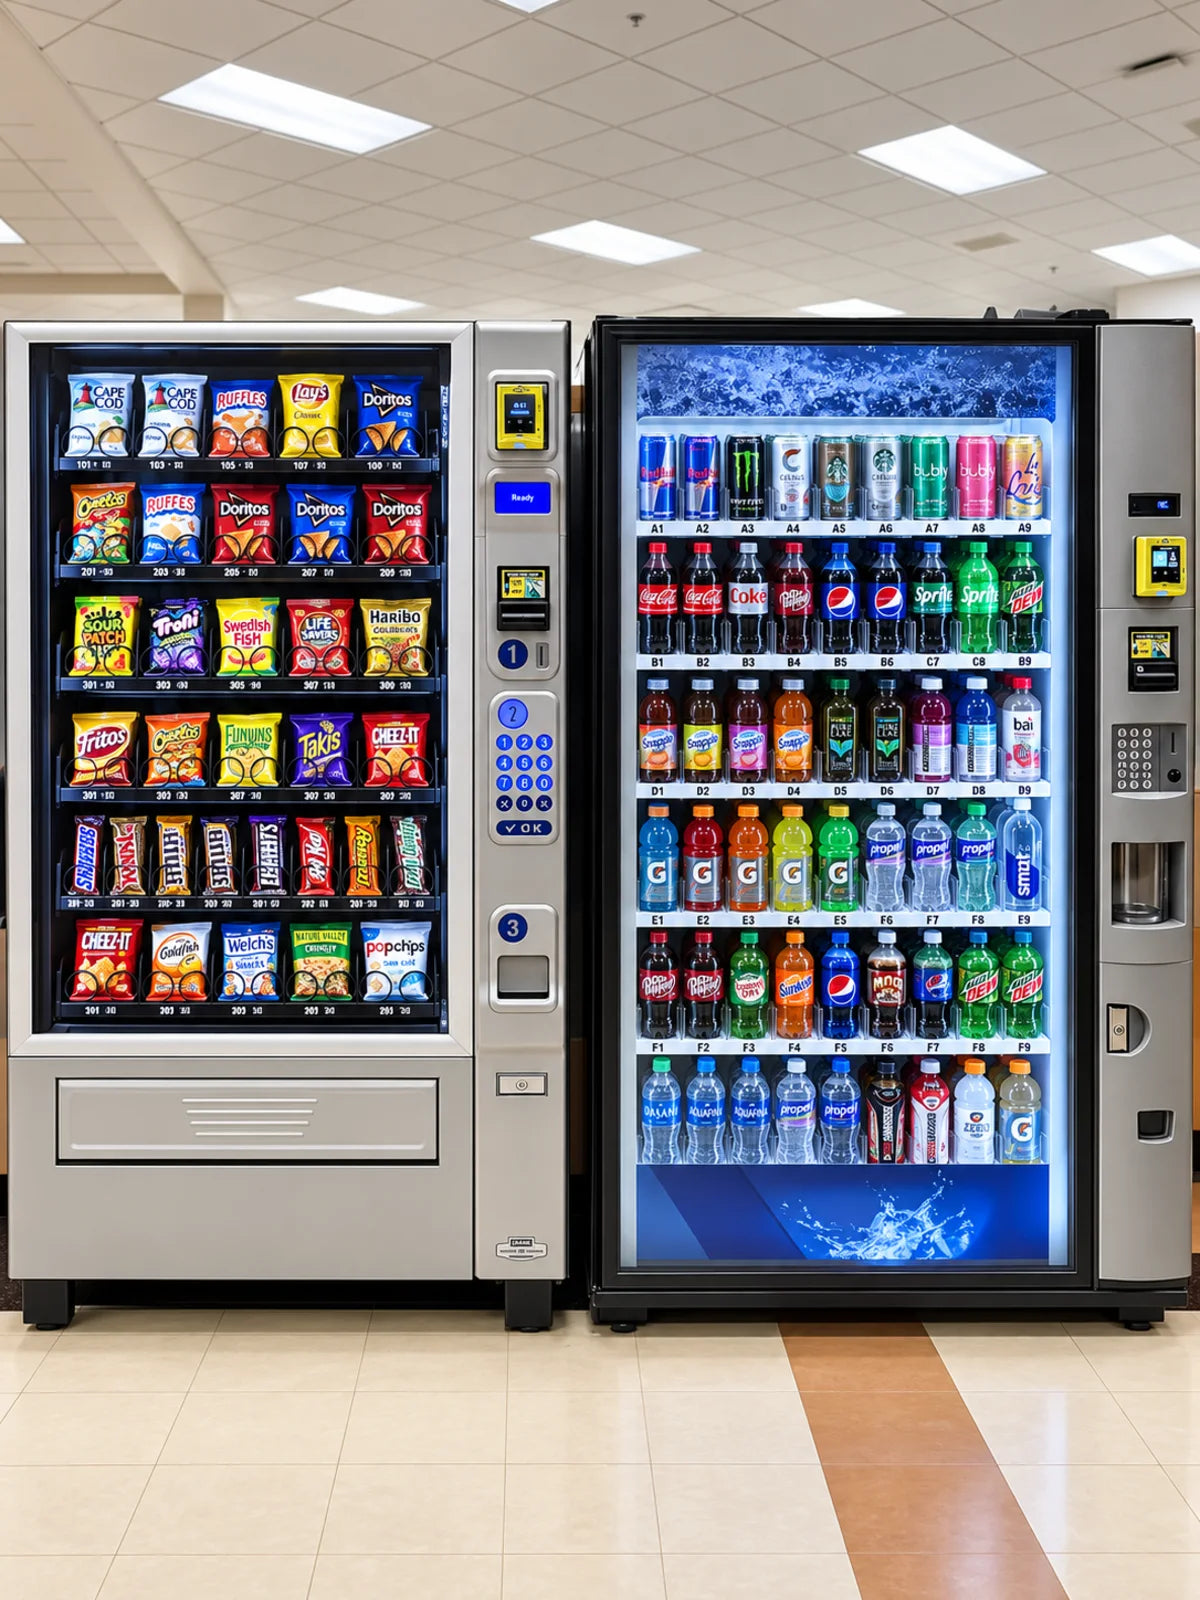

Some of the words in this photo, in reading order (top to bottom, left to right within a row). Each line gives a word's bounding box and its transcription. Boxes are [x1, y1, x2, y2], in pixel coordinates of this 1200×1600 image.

[93, 386, 125, 398] CAPE
[167, 386, 198, 399] CAPE
[293, 383, 329, 402] Lay's
[94, 397, 124, 409] COD
[169, 397, 197, 410] COD
[217, 390, 267, 410] RUFFLES
[363, 392, 412, 408] Doritos
[76, 460, 91, 470] 101
[149, 460, 165, 470] 103
[220, 460, 236, 470] 105
[293, 461, 309, 470] 107
[511, 493, 535, 504] Ready
[220, 501, 270, 517] Doritos
[296, 502, 346, 517] Doritos
[372, 502, 423, 517] Doritos
[651, 523, 664, 534] A1
[695, 523, 709, 534] A2
[741, 523, 755, 534] A3
[786, 523, 800, 534] A4
[878, 523, 893, 534] A6
[925, 523, 939, 534] A7
[971, 523, 986, 534] A8
[1018, 523, 1032, 534] A9
[81, 567, 96, 577] 201
[224, 567, 240, 577] 205
[301, 568, 317, 577] 207
[730, 587, 768, 604] Coke
[1011, 586, 1043, 613] DEW
[84, 619, 122, 633] SOUR
[305, 617, 332, 630] LIFE
[82, 630, 126, 645] PATCH
[507, 644, 517, 664] 1
[651, 657, 663, 668] B1
[696, 657, 710, 668] B2
[742, 657, 755, 668] B3
[787, 657, 801, 668] B4
[880, 657, 894, 668] B6
[926, 657, 940, 667] C7
[972, 657, 986, 667] C8
[1018, 656, 1032, 667] B9
[82, 680, 97, 690] 301
[229, 680, 246, 690] 305
[508, 705, 518, 723] 2
[1013, 717, 1033, 731] bai
[76, 728, 127, 757] Fritos
[298, 731, 342, 765] Takis
[501, 737, 507, 748] 1
[521, 737, 529, 749] 2
[540, 737, 549, 748] 3
[540, 758, 548, 769] 6
[500, 777, 509, 788] 7
[521, 777, 529, 789] 8
[82, 790, 97, 800] 301
[651, 786, 664, 796] D1
[696, 786, 710, 796] D2
[742, 786, 755, 796] D3
[787, 786, 801, 796] D4
[880, 786, 894, 796] D6
[926, 786, 940, 796] D7
[972, 785, 986, 796] D8
[1018, 785, 1032, 796] D9
[520, 823, 543, 834] OK
[647, 860, 666, 884] G
[692, 860, 712, 884] G
[737, 860, 757, 884] G
[782, 860, 802, 884] G
[828, 860, 848, 884] G
[651, 915, 664, 926] E1
[696, 915, 710, 926] E2
[742, 915, 755, 926] E3
[787, 915, 800, 926] E4
[880, 915, 894, 926] F6
[926, 915, 939, 925] F7
[971, 915, 985, 925] F8
[1018, 914, 1031, 925] E9
[507, 919, 520, 937] 3
[227, 936, 275, 953] Welch's
[366, 940, 425, 958] popchips
[967, 974, 999, 1003] DEW
[1012, 974, 1043, 1003] DEW
[652, 1042, 664, 1053] F1
[697, 1042, 710, 1053] F2
[743, 1042, 756, 1053] F3
[788, 1042, 801, 1053] F4
[881, 1042, 894, 1053] F6
[927, 1042, 940, 1053] F7
[972, 1042, 986, 1053] F8
[1018, 1042, 1031, 1053] F9
[1010, 1117, 1032, 1142] G
